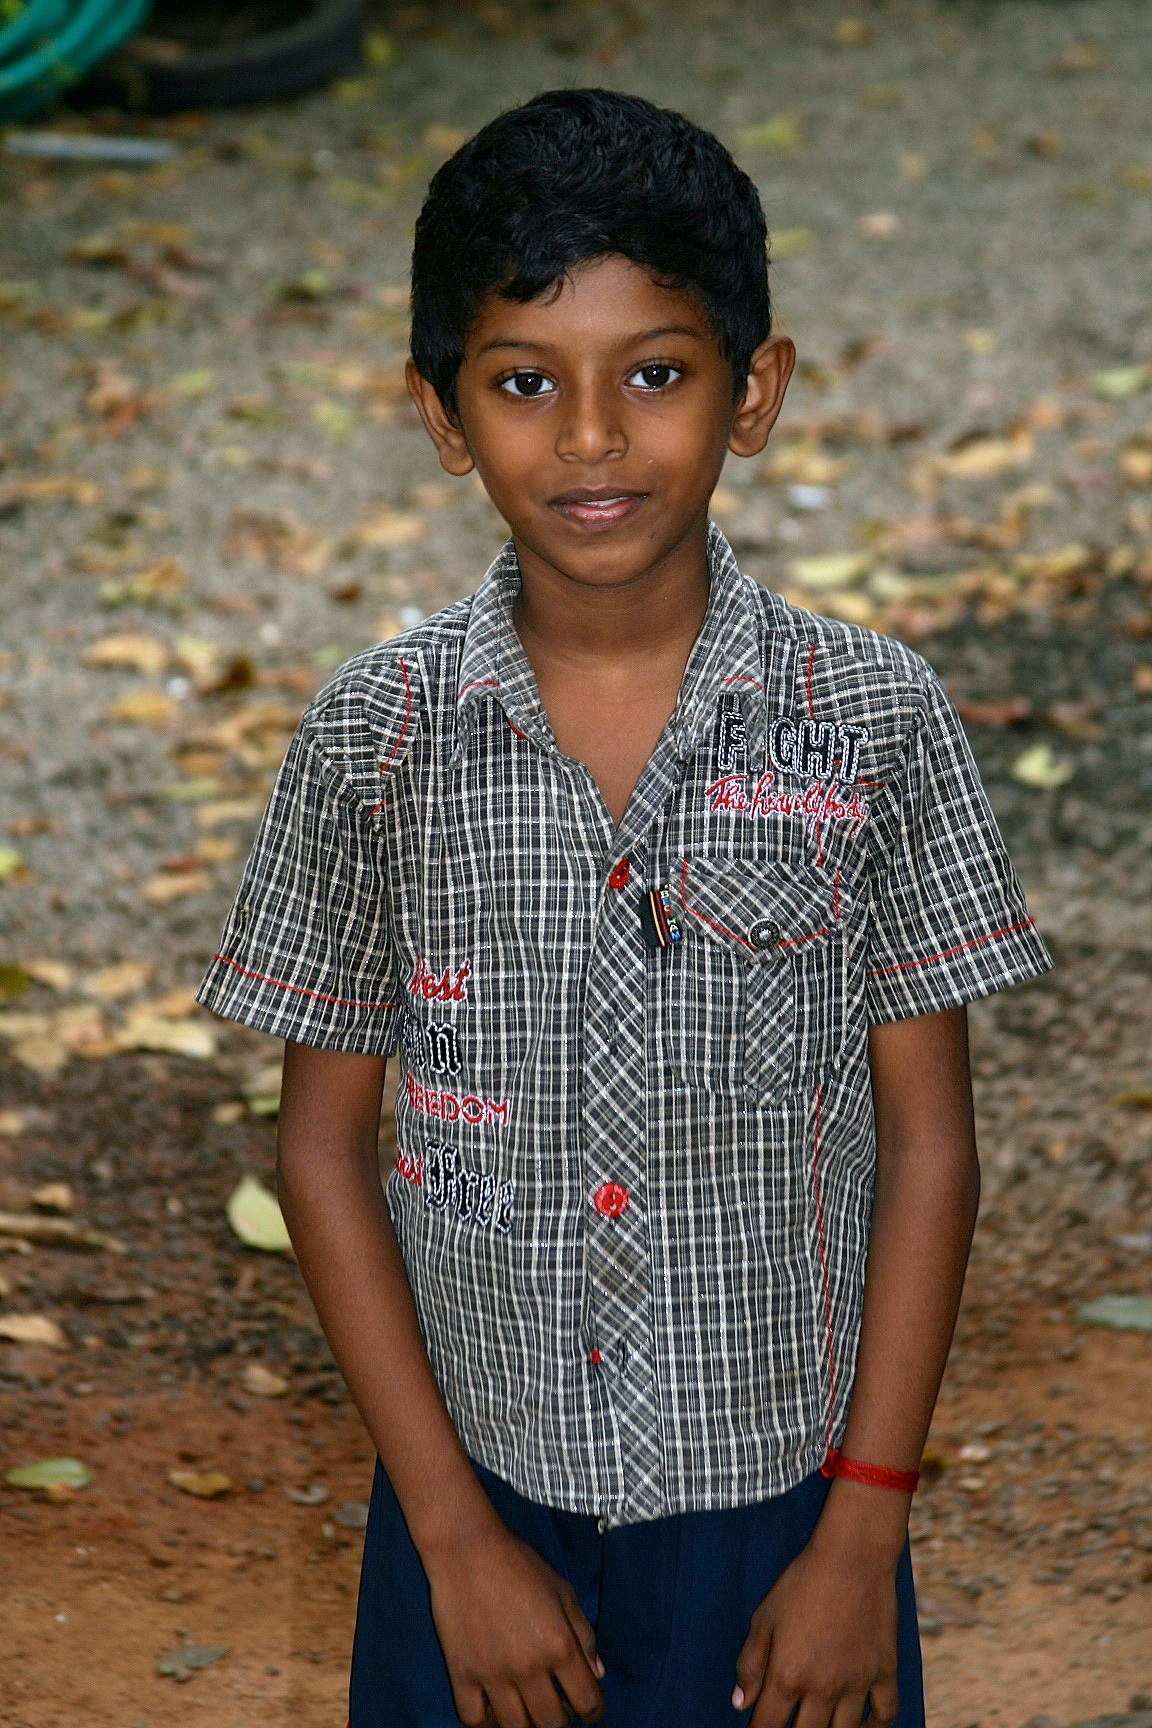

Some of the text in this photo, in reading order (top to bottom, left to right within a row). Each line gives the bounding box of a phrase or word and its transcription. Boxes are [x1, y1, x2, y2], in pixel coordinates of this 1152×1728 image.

[717, 710, 869, 784] FGHT
[705, 773, 748, 814] The
[660, 890, 681, 941] BECHAM
